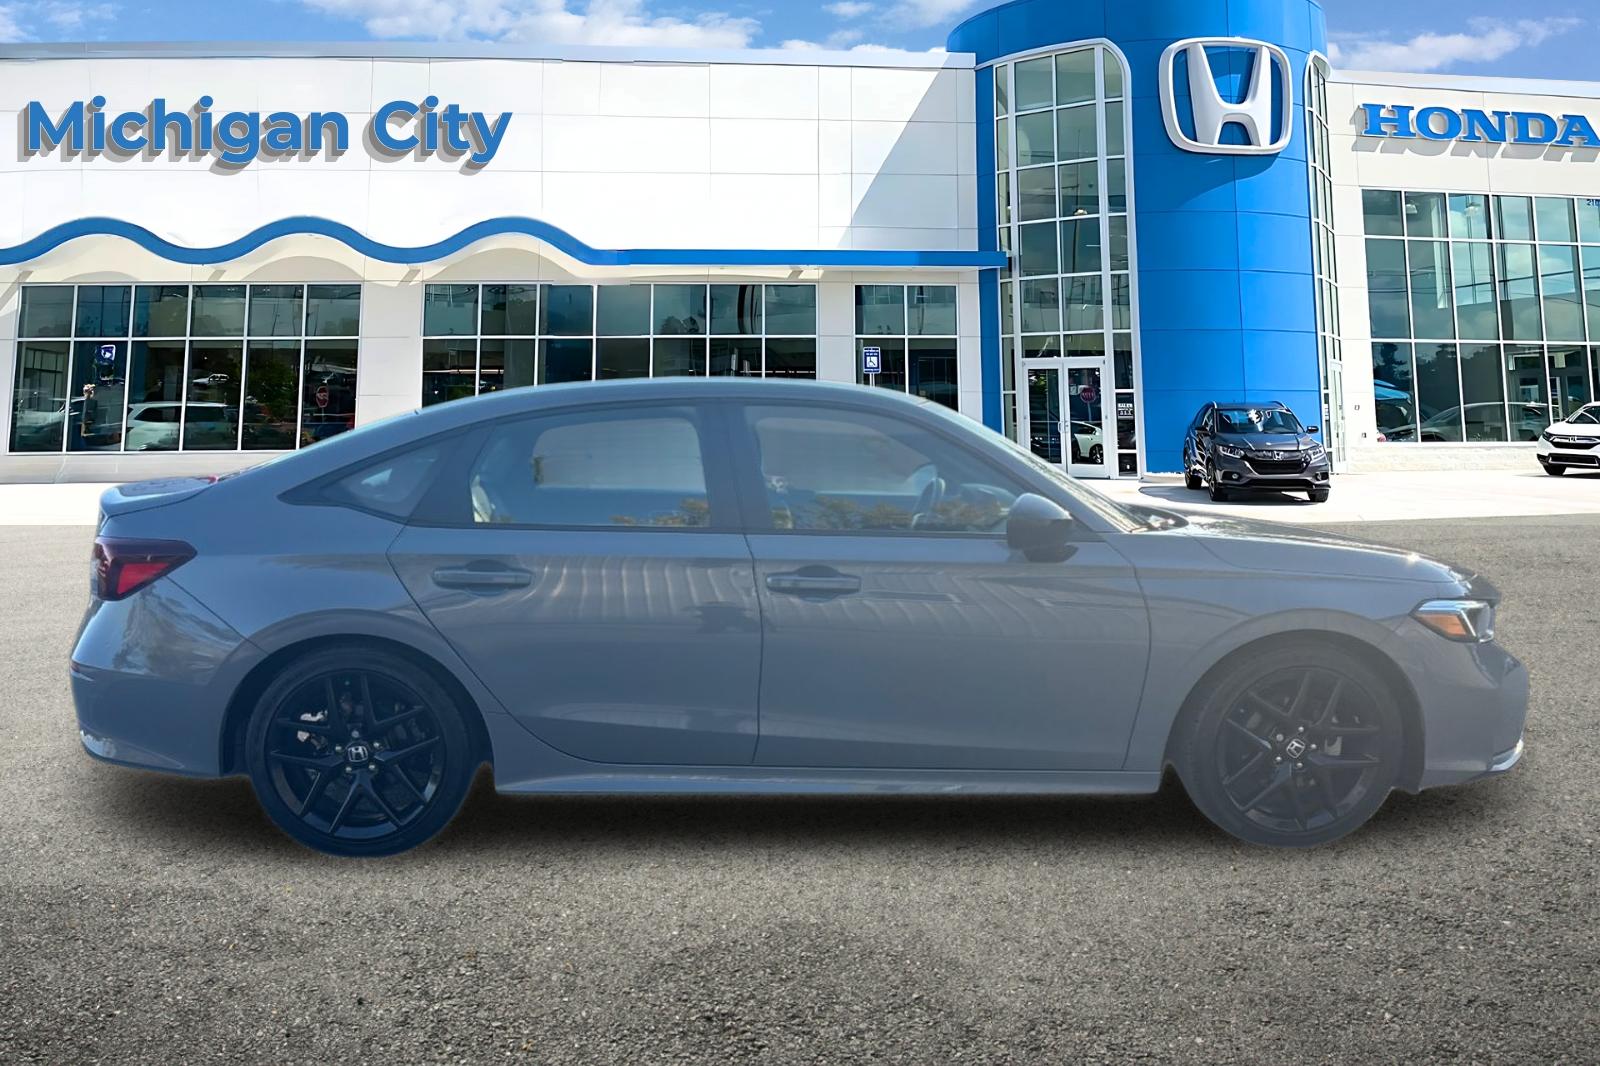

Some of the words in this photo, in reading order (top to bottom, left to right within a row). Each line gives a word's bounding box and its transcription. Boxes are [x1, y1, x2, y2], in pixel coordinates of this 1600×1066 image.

[28, 95, 349, 164] Michigan
[374, 95, 513, 164] City
[1361, 103, 1600, 148] HONDA
